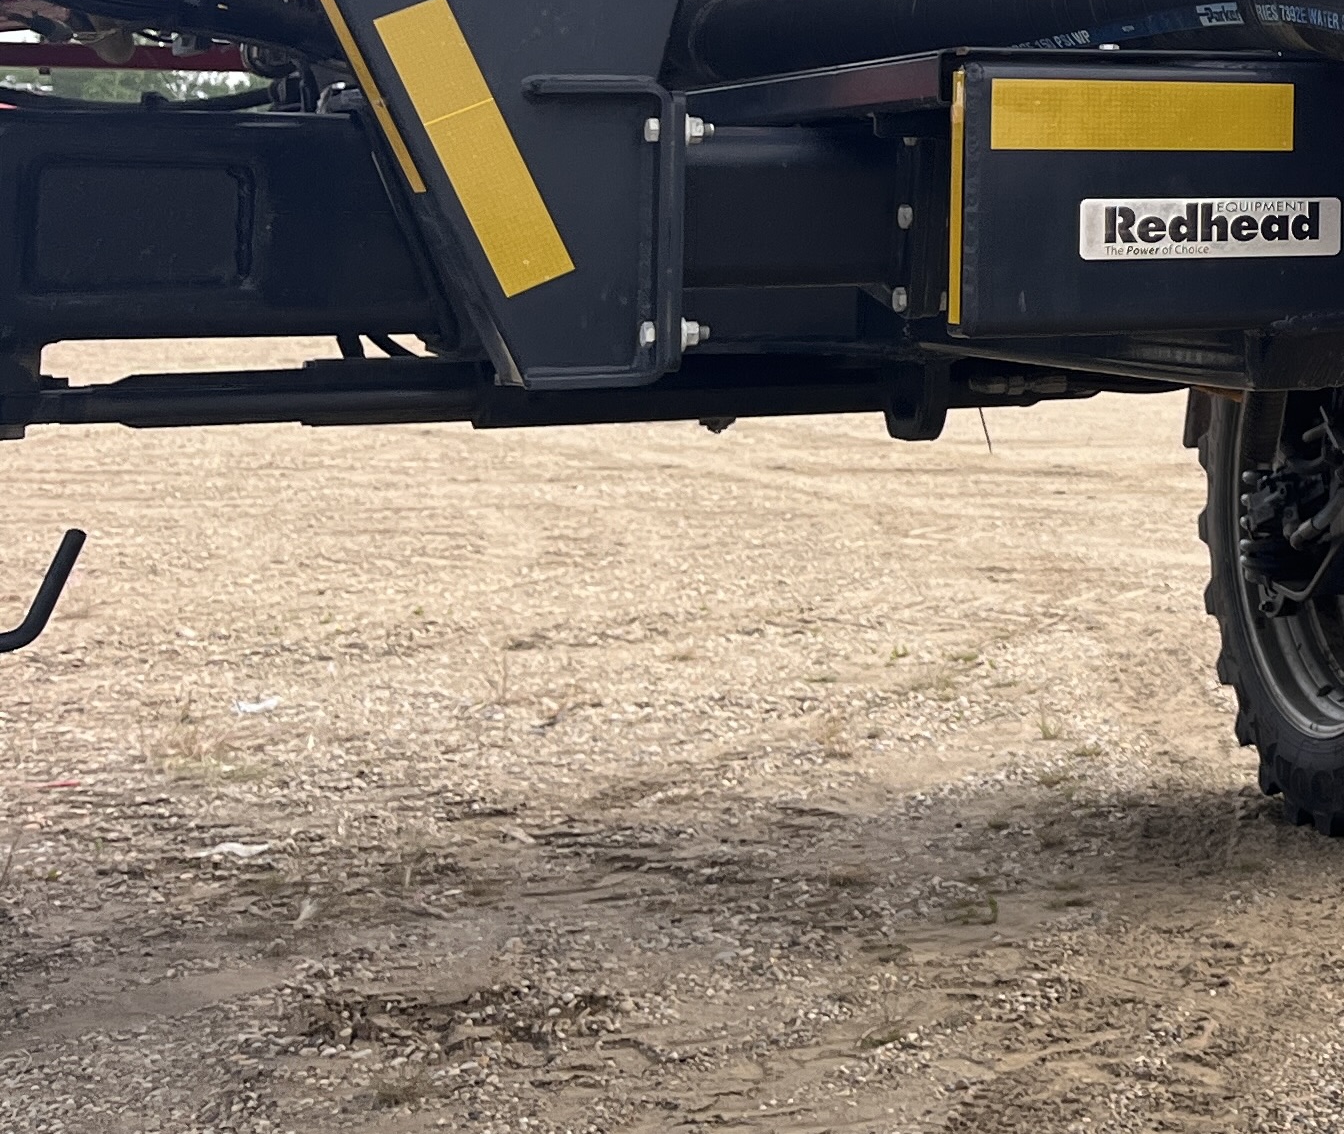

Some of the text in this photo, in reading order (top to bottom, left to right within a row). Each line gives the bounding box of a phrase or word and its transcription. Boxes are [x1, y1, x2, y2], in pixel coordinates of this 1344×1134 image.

[1255, 4, 1279, 22] RIES
[1307, 7, 1340, 31] WATER
[1216, 201, 1306, 214] EQUIPMENT
[1104, 201, 1321, 244] Redhead
[1105, 243, 1210, 256] The Power of Choice
